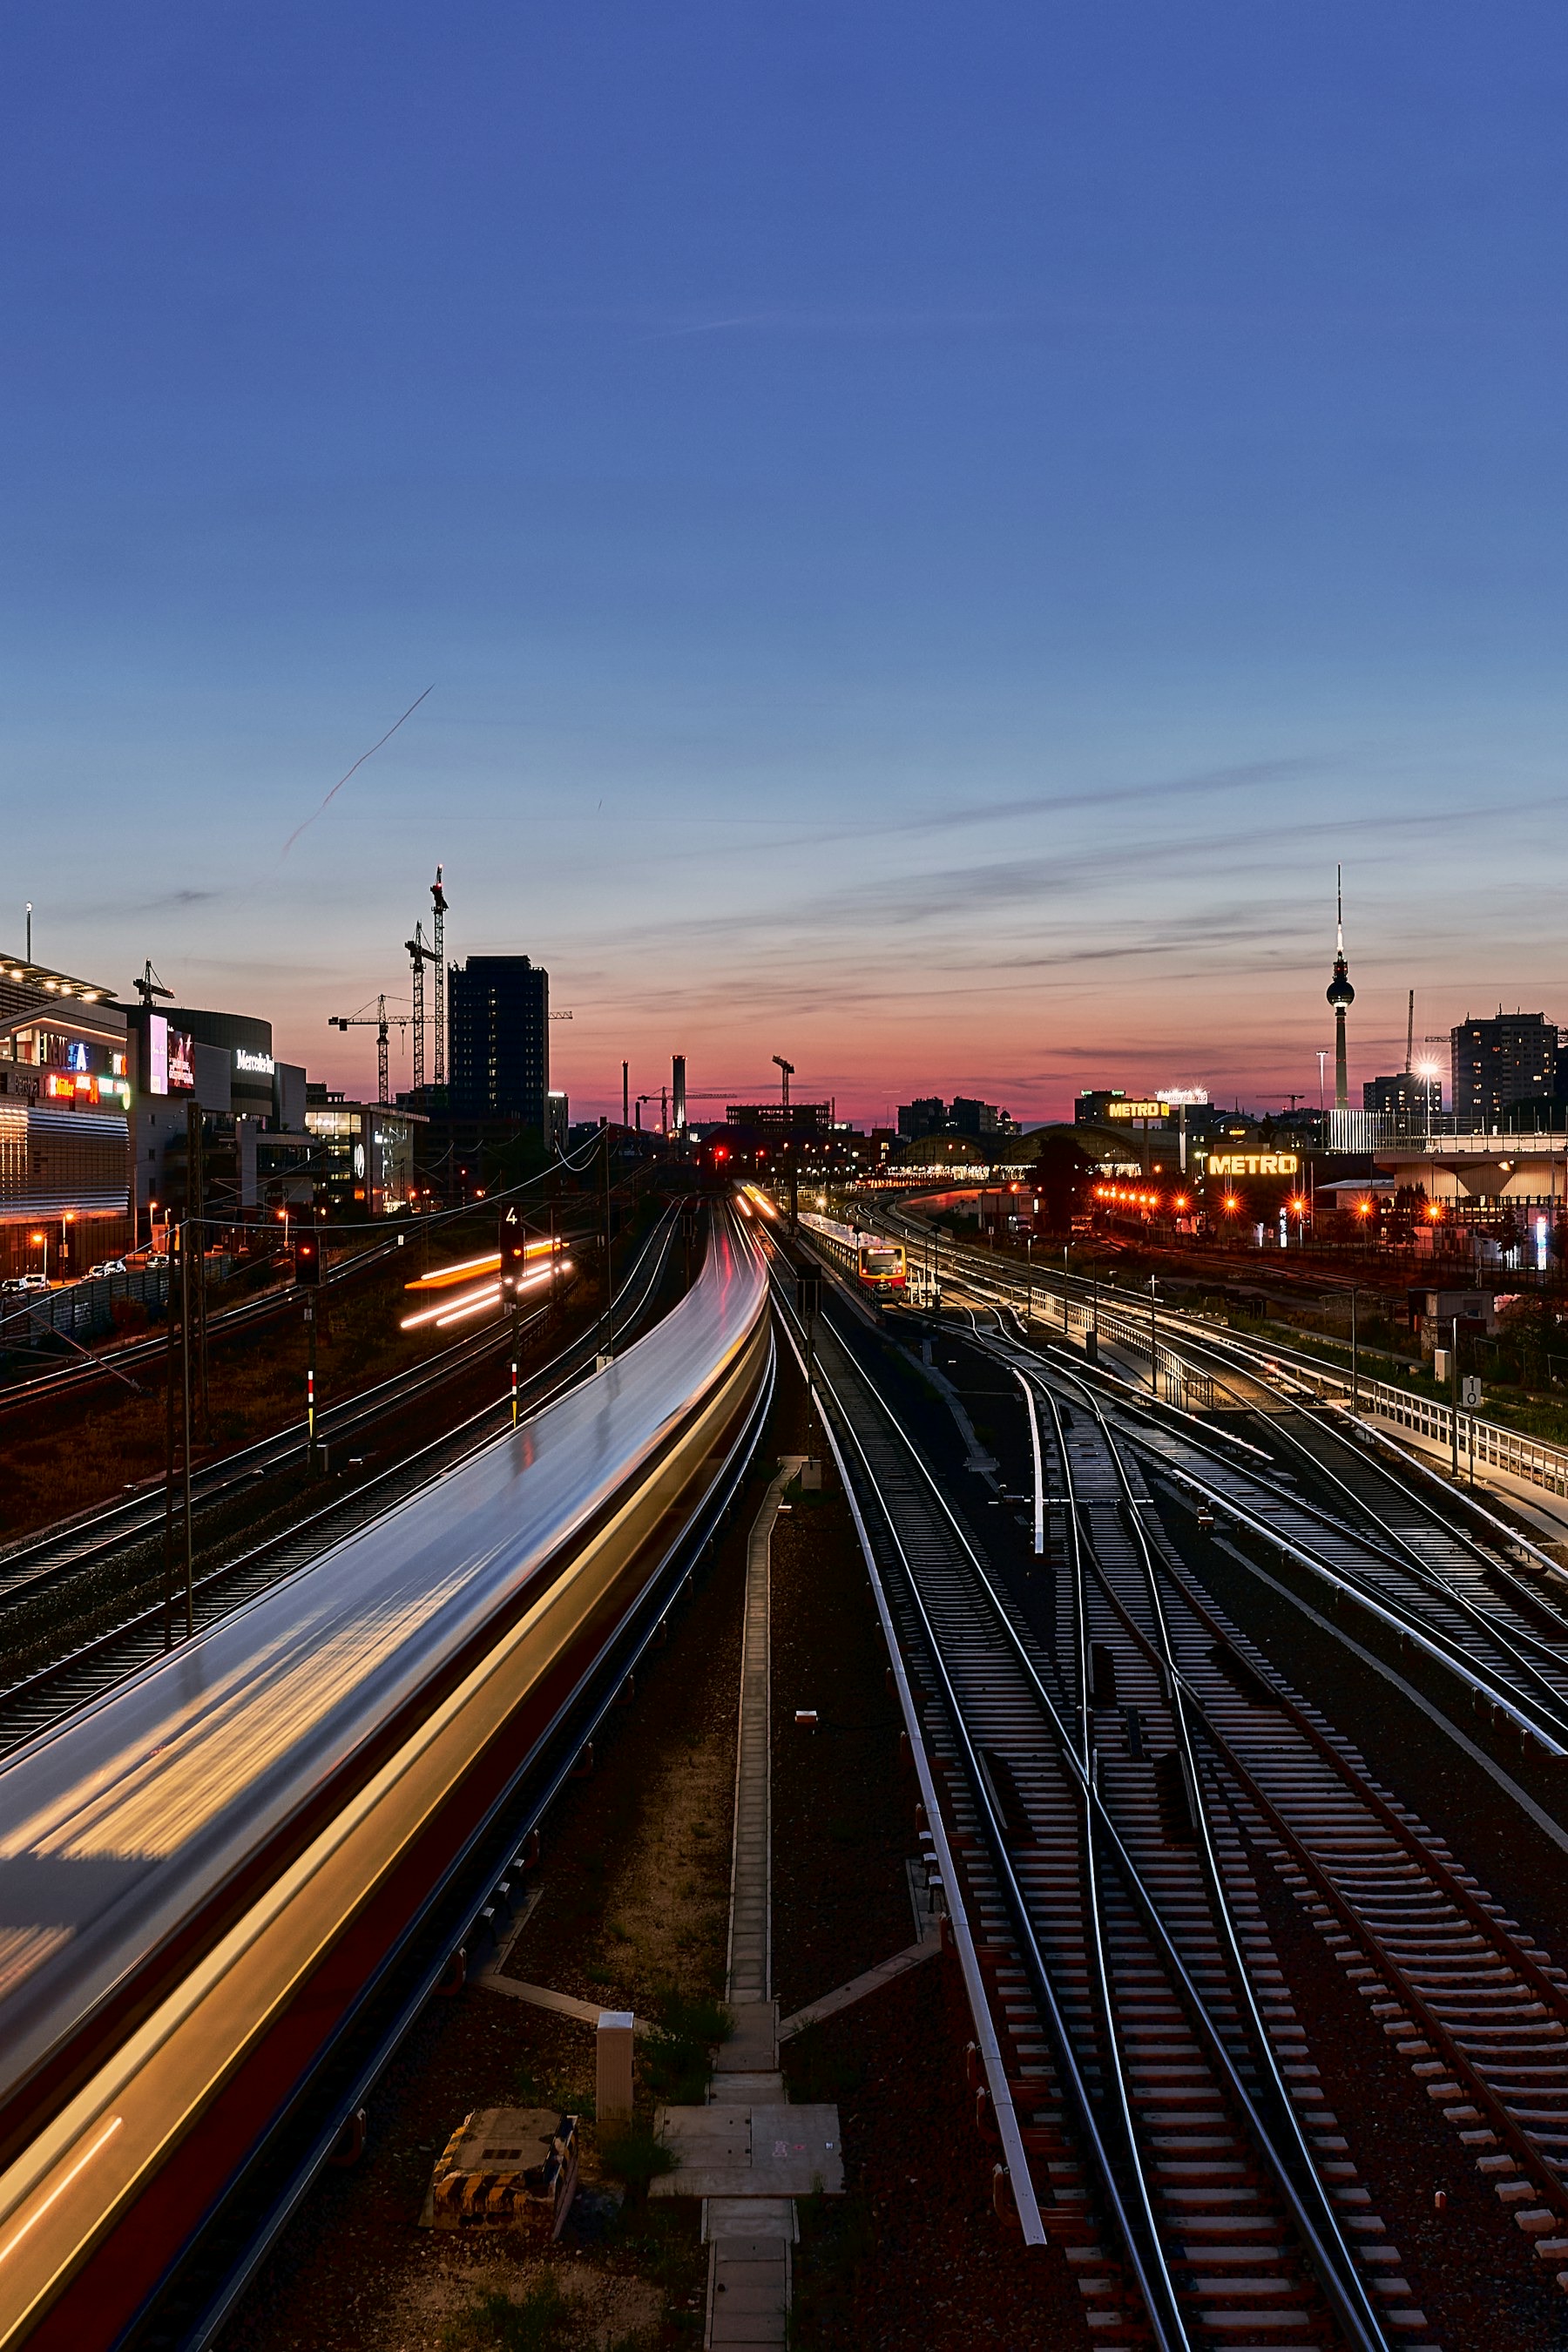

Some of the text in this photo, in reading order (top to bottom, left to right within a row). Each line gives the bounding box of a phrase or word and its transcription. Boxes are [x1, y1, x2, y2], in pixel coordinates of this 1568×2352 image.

[57, 1078, 74, 1097] Müller
[1110, 1103, 1159, 1117] METRO
[1210, 1156, 1297, 1173] METRO
[506, 1206, 517, 1225] 4
